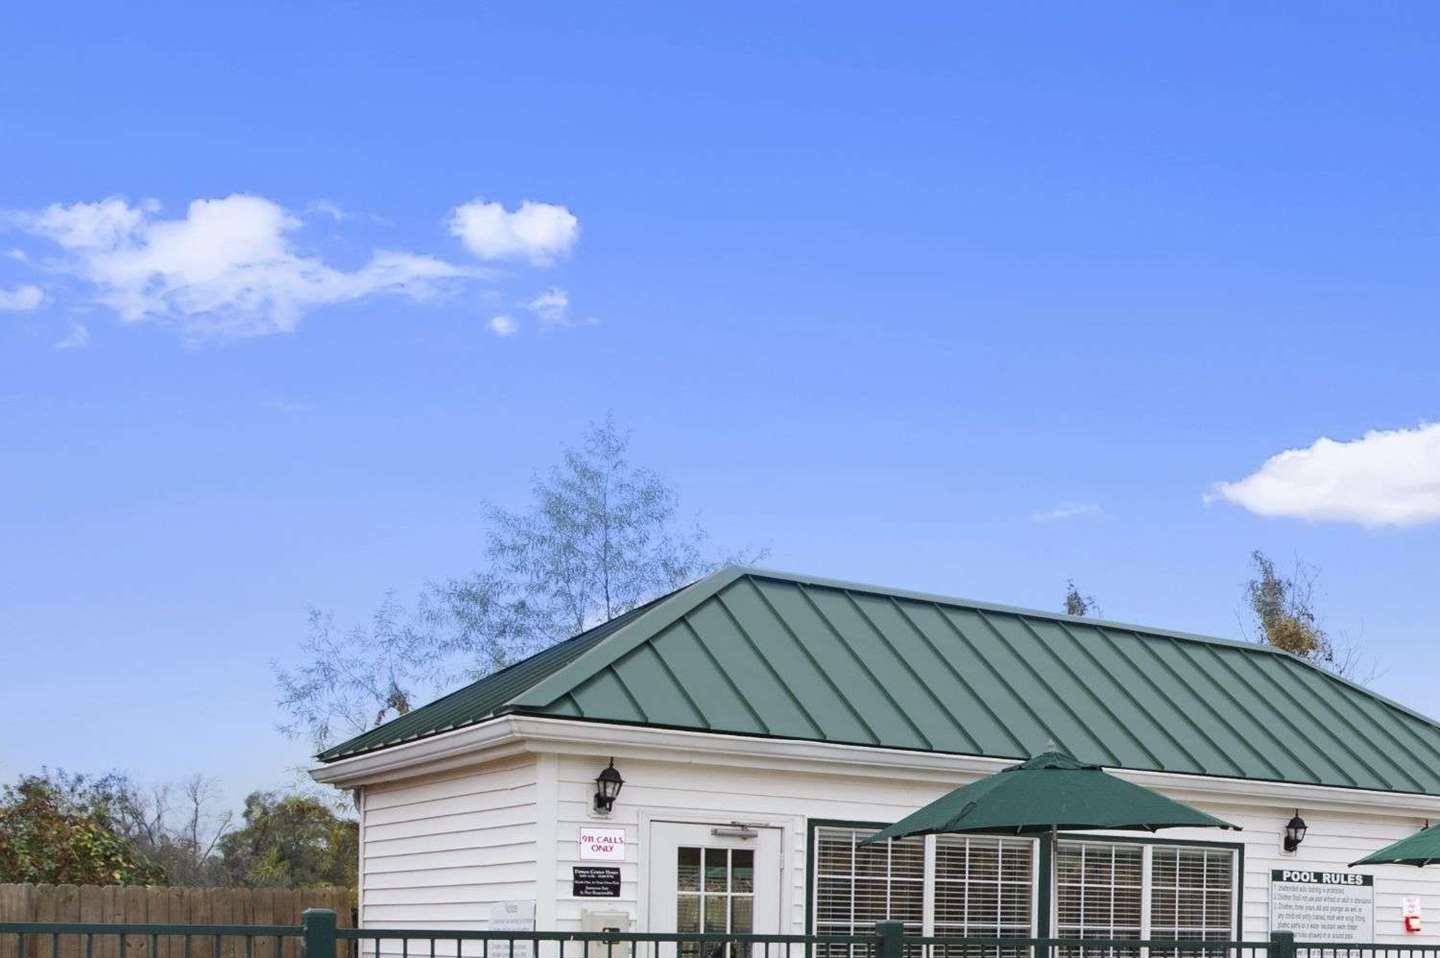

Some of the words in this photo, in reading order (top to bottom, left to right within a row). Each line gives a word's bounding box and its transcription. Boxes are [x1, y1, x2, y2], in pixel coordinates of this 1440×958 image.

[596, 836, 624, 845] CALLS
[591, 844, 614, 852] ONLY
[1282, 871, 1318, 883] POOL
[1322, 873, 1364, 885] RULES
